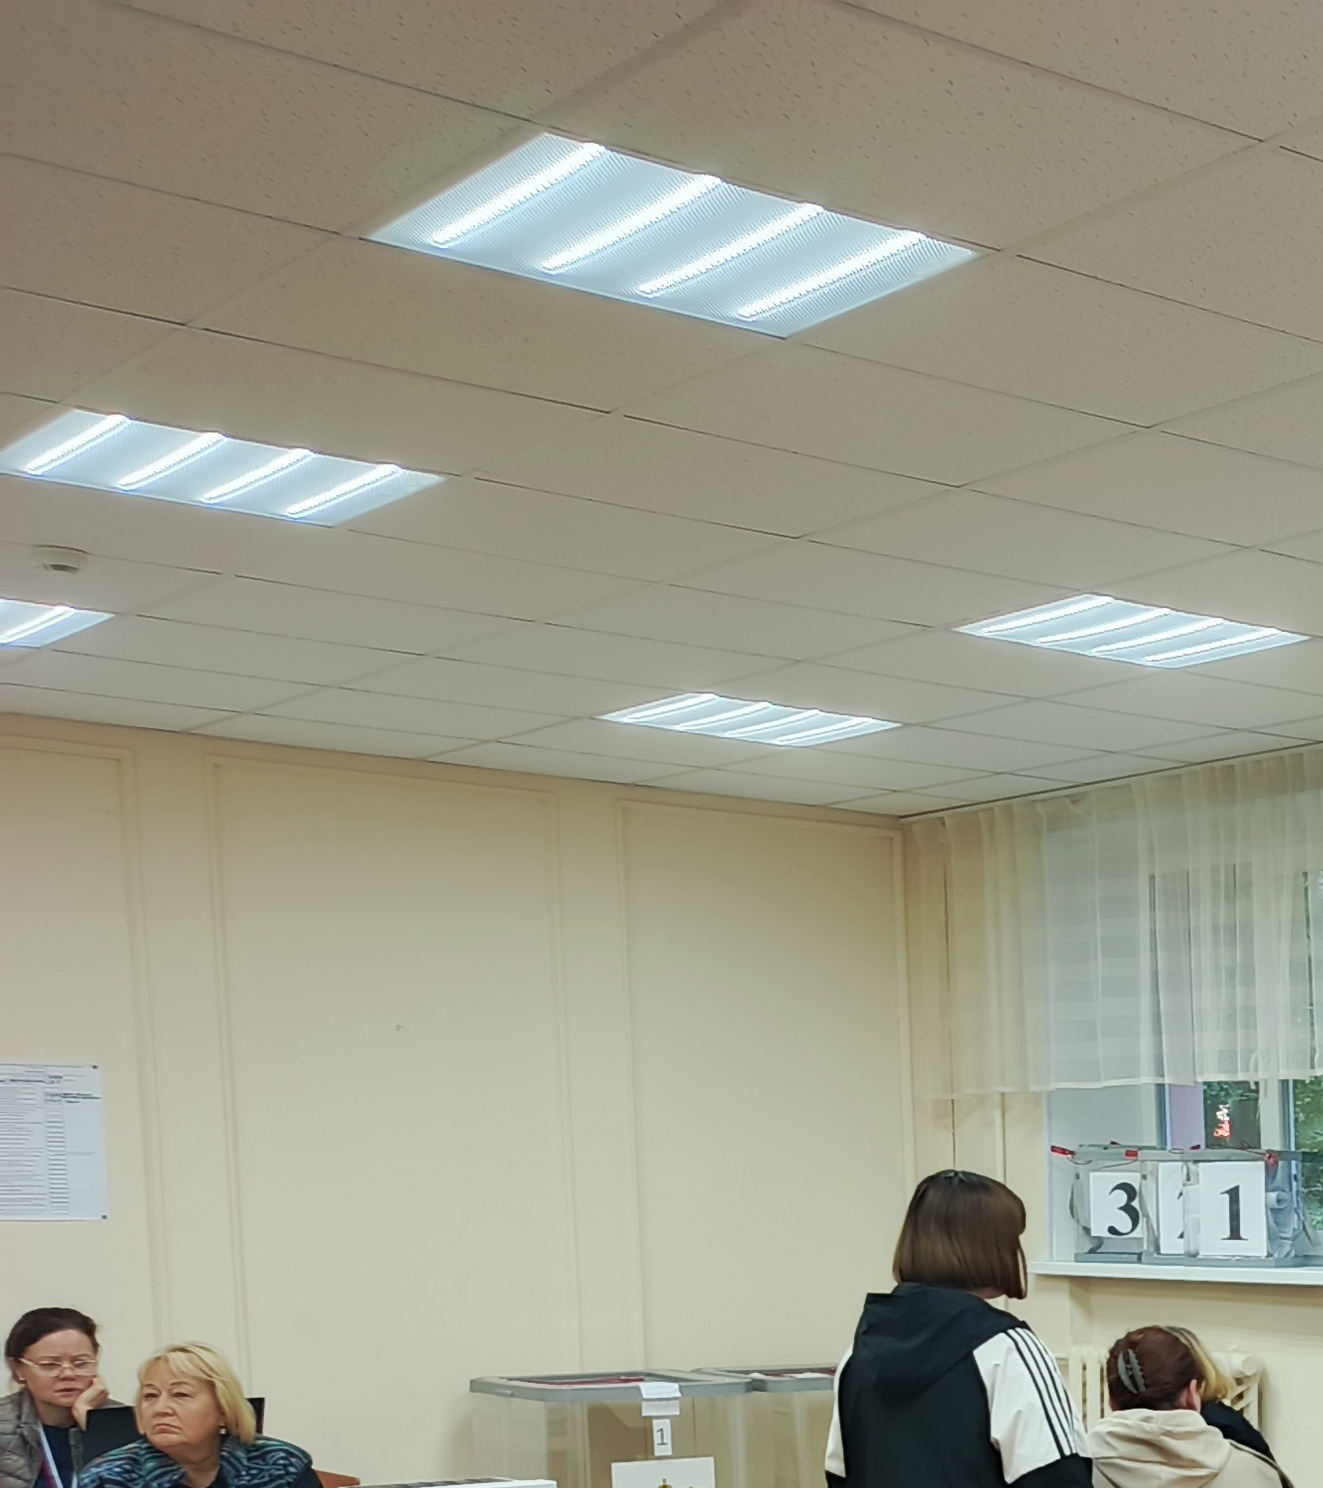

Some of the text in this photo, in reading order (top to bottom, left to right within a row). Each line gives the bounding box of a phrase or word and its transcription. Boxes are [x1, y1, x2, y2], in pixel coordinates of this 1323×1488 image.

[1107, 1182, 1140, 1236] 3
[1220, 1184, 1249, 1241] 1
[656, 1427, 668, 1446] 1
